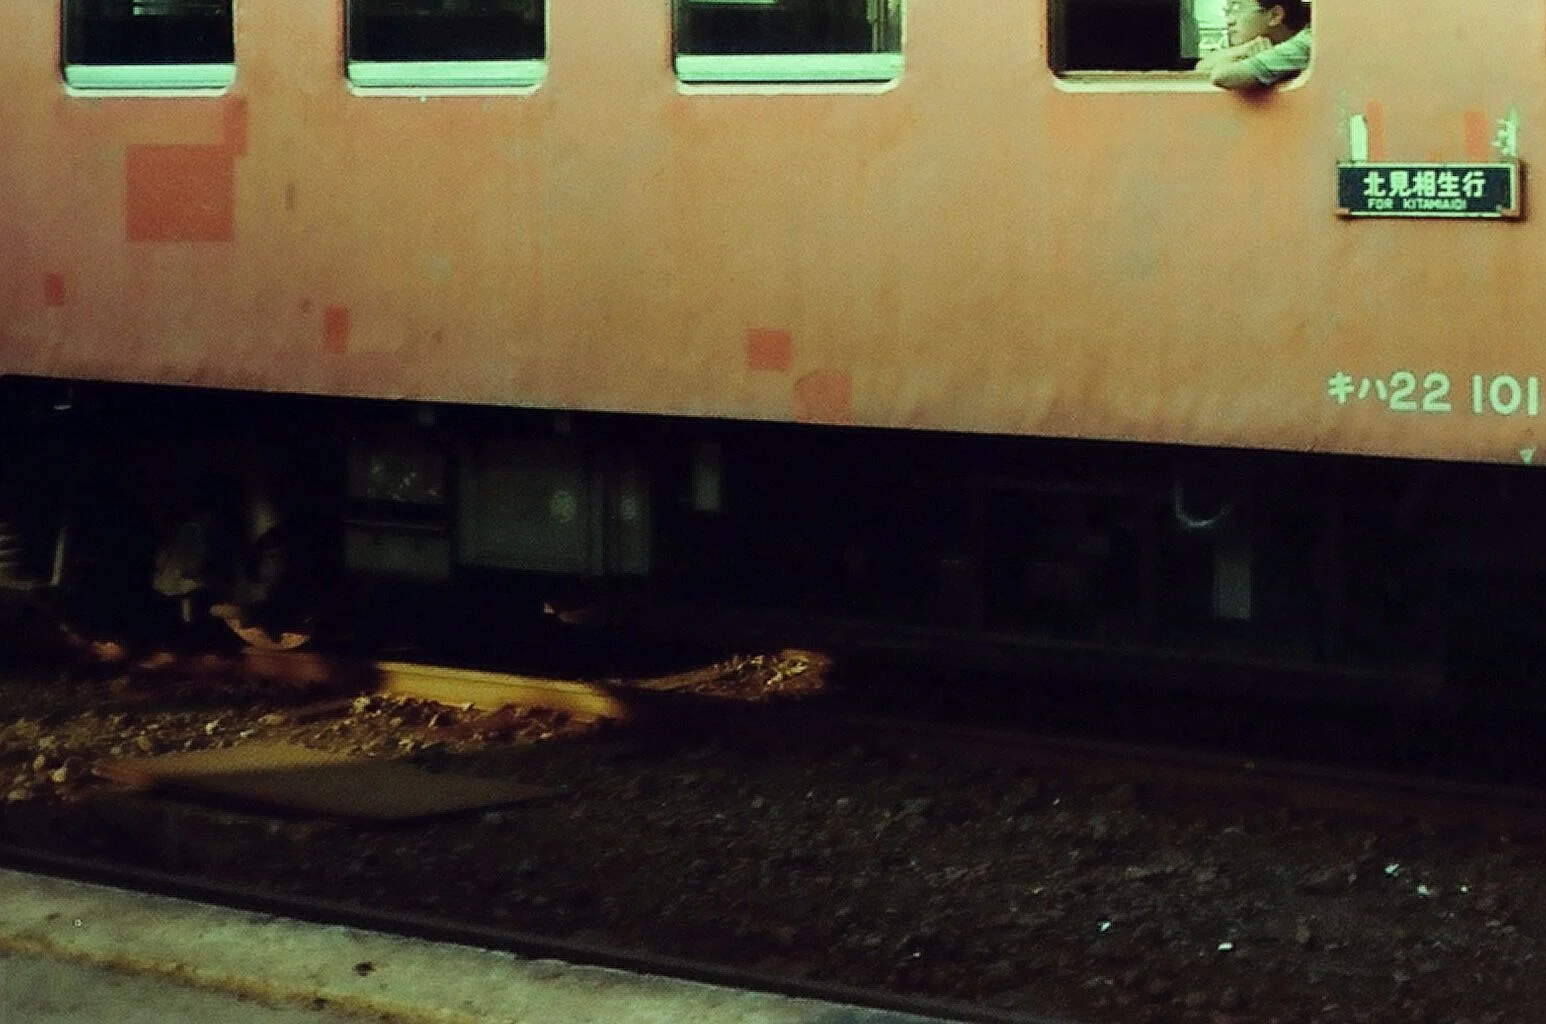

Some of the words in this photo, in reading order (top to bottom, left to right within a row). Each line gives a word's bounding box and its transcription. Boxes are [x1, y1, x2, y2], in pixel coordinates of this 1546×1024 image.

[1363, 170, 1486, 197] 北見相生行
[1367, 198, 1394, 210] FOR
[1328, 371, 1451, 412] キハ22
[1473, 374, 1539, 416] 101
